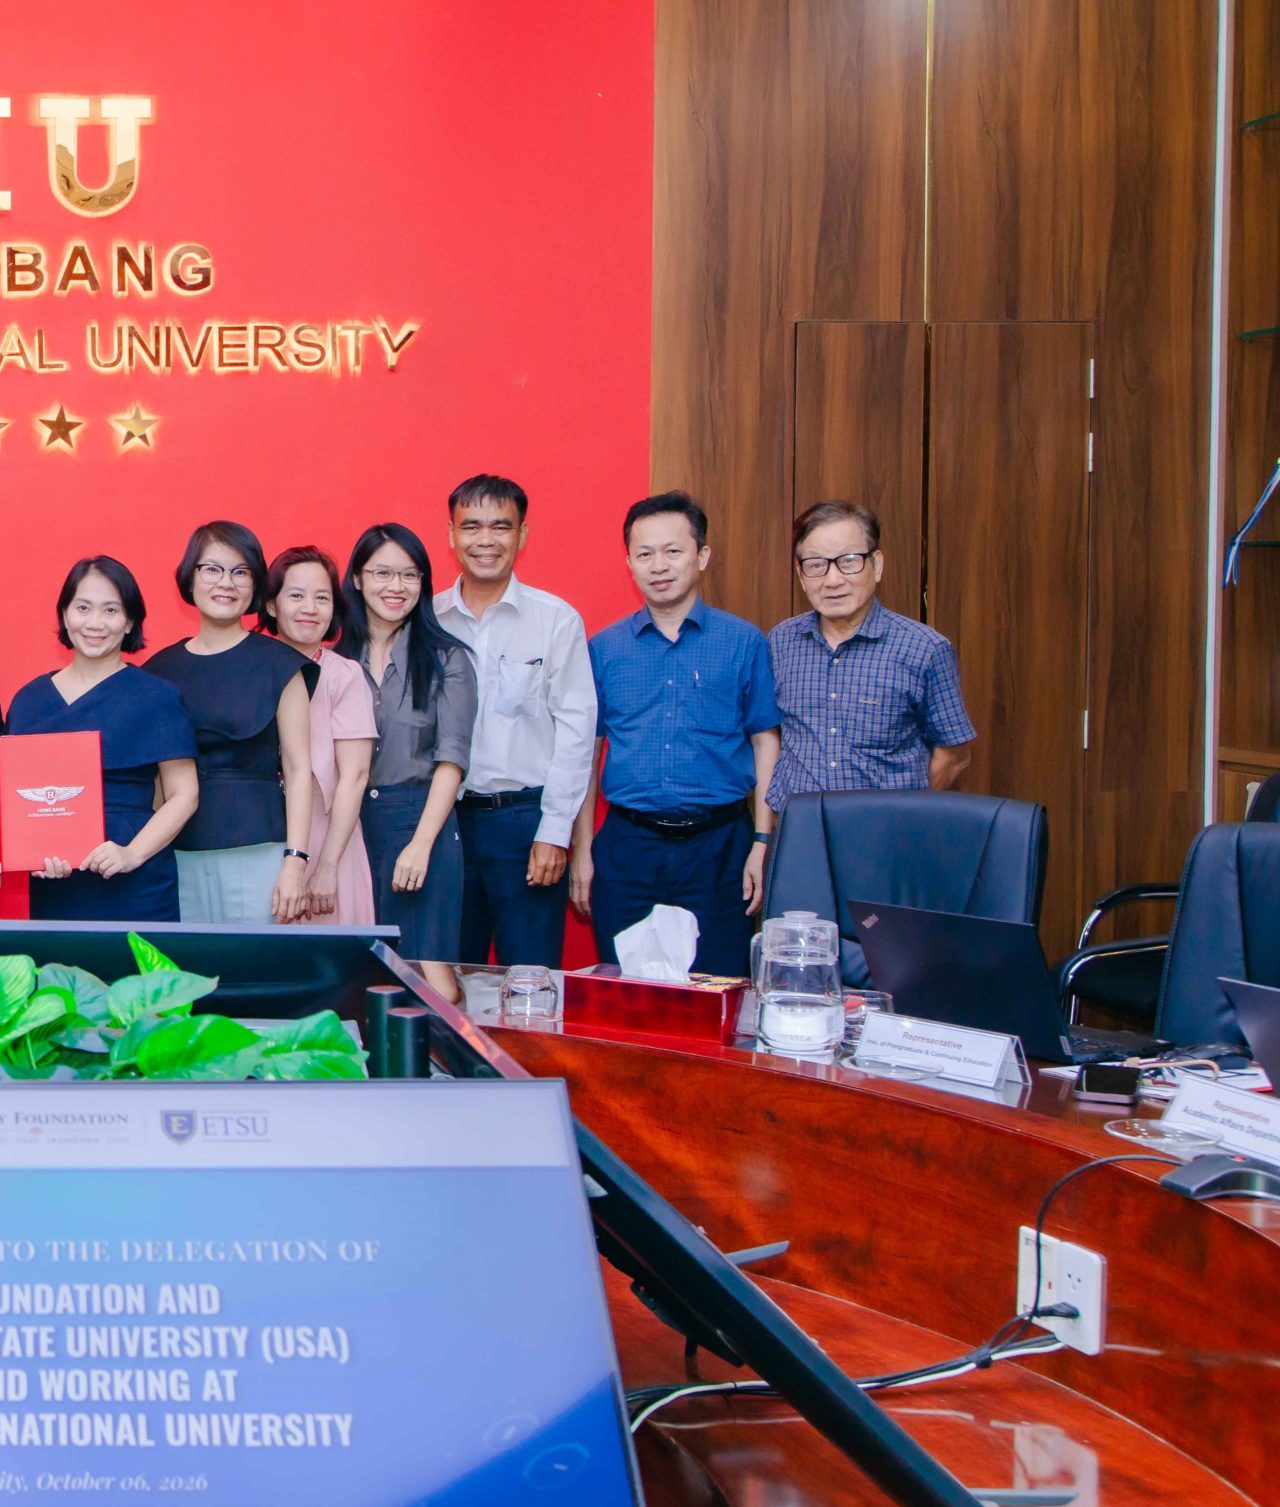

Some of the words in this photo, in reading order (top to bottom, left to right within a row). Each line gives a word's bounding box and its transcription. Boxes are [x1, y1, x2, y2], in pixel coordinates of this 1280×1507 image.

[5, 244, 213, 294] BANG
[87, 322, 418, 373] UNIVERSITY
[902, 1031, 963, 1050] Representative
[202, 1115, 269, 1137] ETSU
[46, 1240, 110, 1262] THE
[121, 1241, 328, 1262] DELEGATION
[338, 1241, 381, 1262] OF
[157, 1284, 220, 1315] AND
[66, 1327, 248, 1358] UNIVERSITY
[261, 1327, 349, 1363] (USA)
[39, 1370, 191, 1402] WORKING
[202, 1370, 238, 1402] AT
[165, 1414, 353, 1447] UNIVERSITY
[36, 1472, 116, 1491] October
